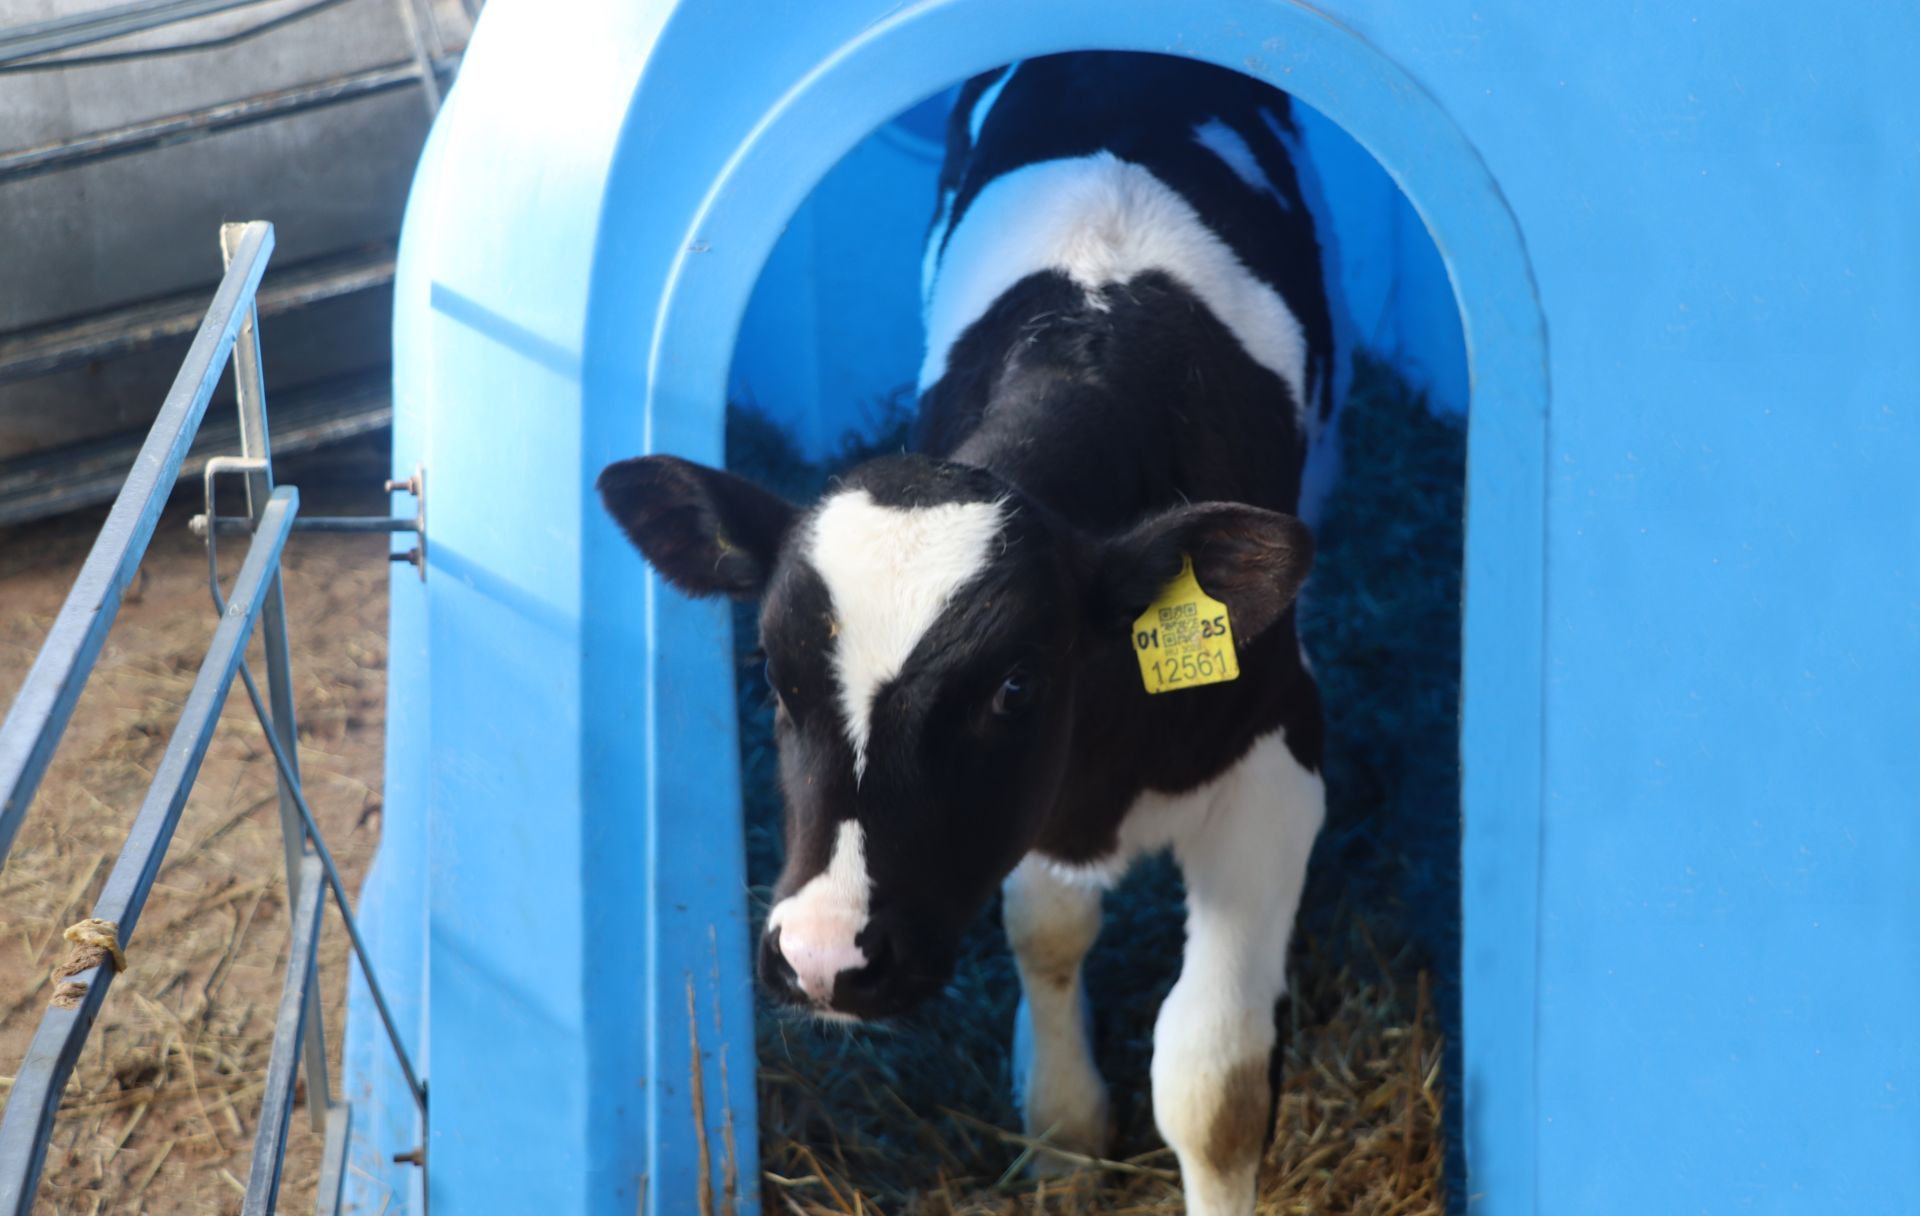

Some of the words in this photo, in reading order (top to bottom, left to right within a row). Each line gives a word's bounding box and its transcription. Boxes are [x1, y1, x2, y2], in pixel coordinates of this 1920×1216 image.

[1137, 628, 1159, 650] 01
[1201, 616, 1226, 639] 25
[1152, 649, 1226, 685] 12561
